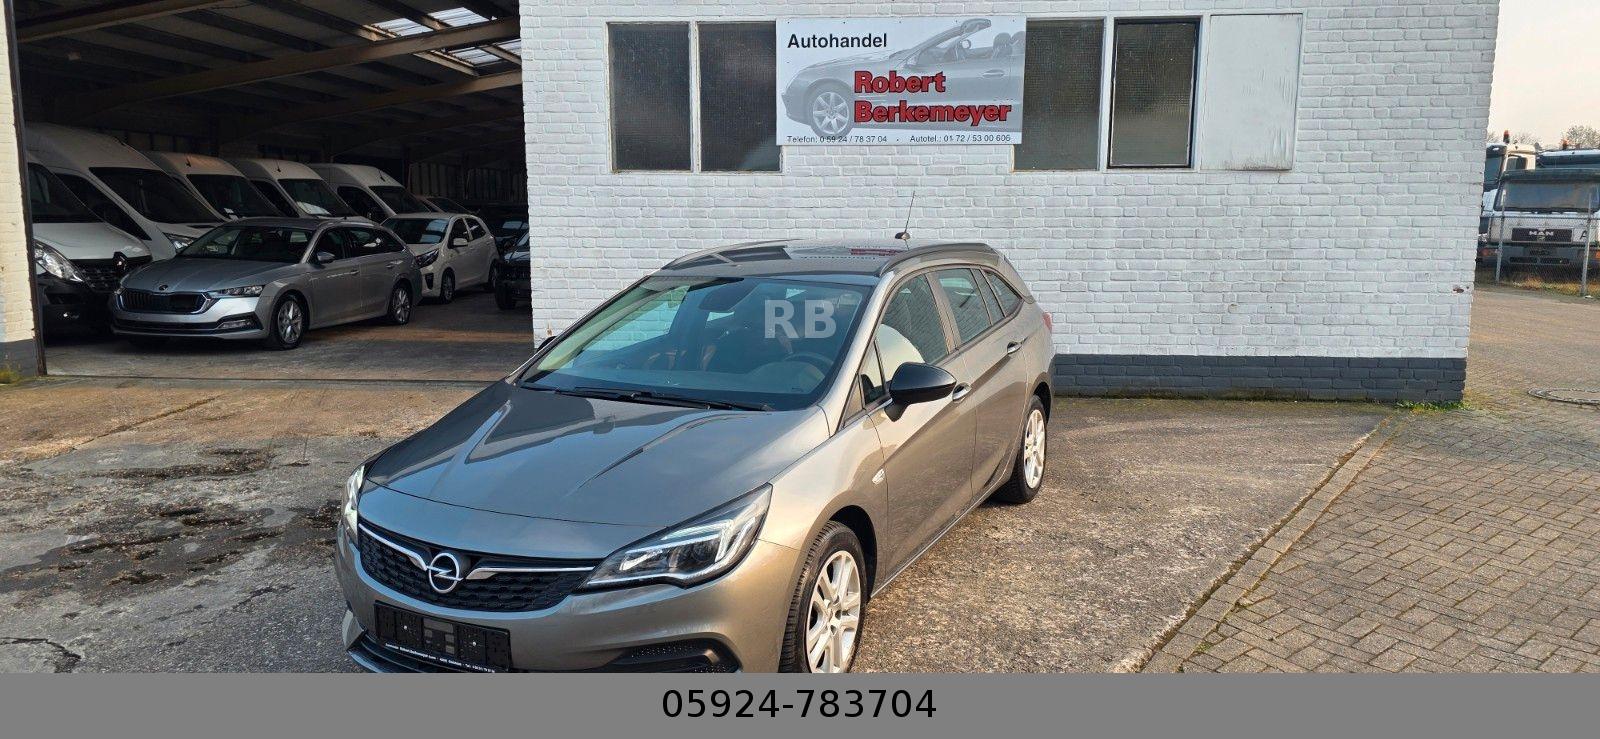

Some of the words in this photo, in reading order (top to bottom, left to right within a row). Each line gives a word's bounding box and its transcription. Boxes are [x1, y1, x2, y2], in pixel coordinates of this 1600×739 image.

[787, 33, 887, 48] Autohandel
[854, 70, 946, 94] Robert
[854, 100, 1012, 126] Berkemeyer
[787, 135, 818, 143] Telefon:
